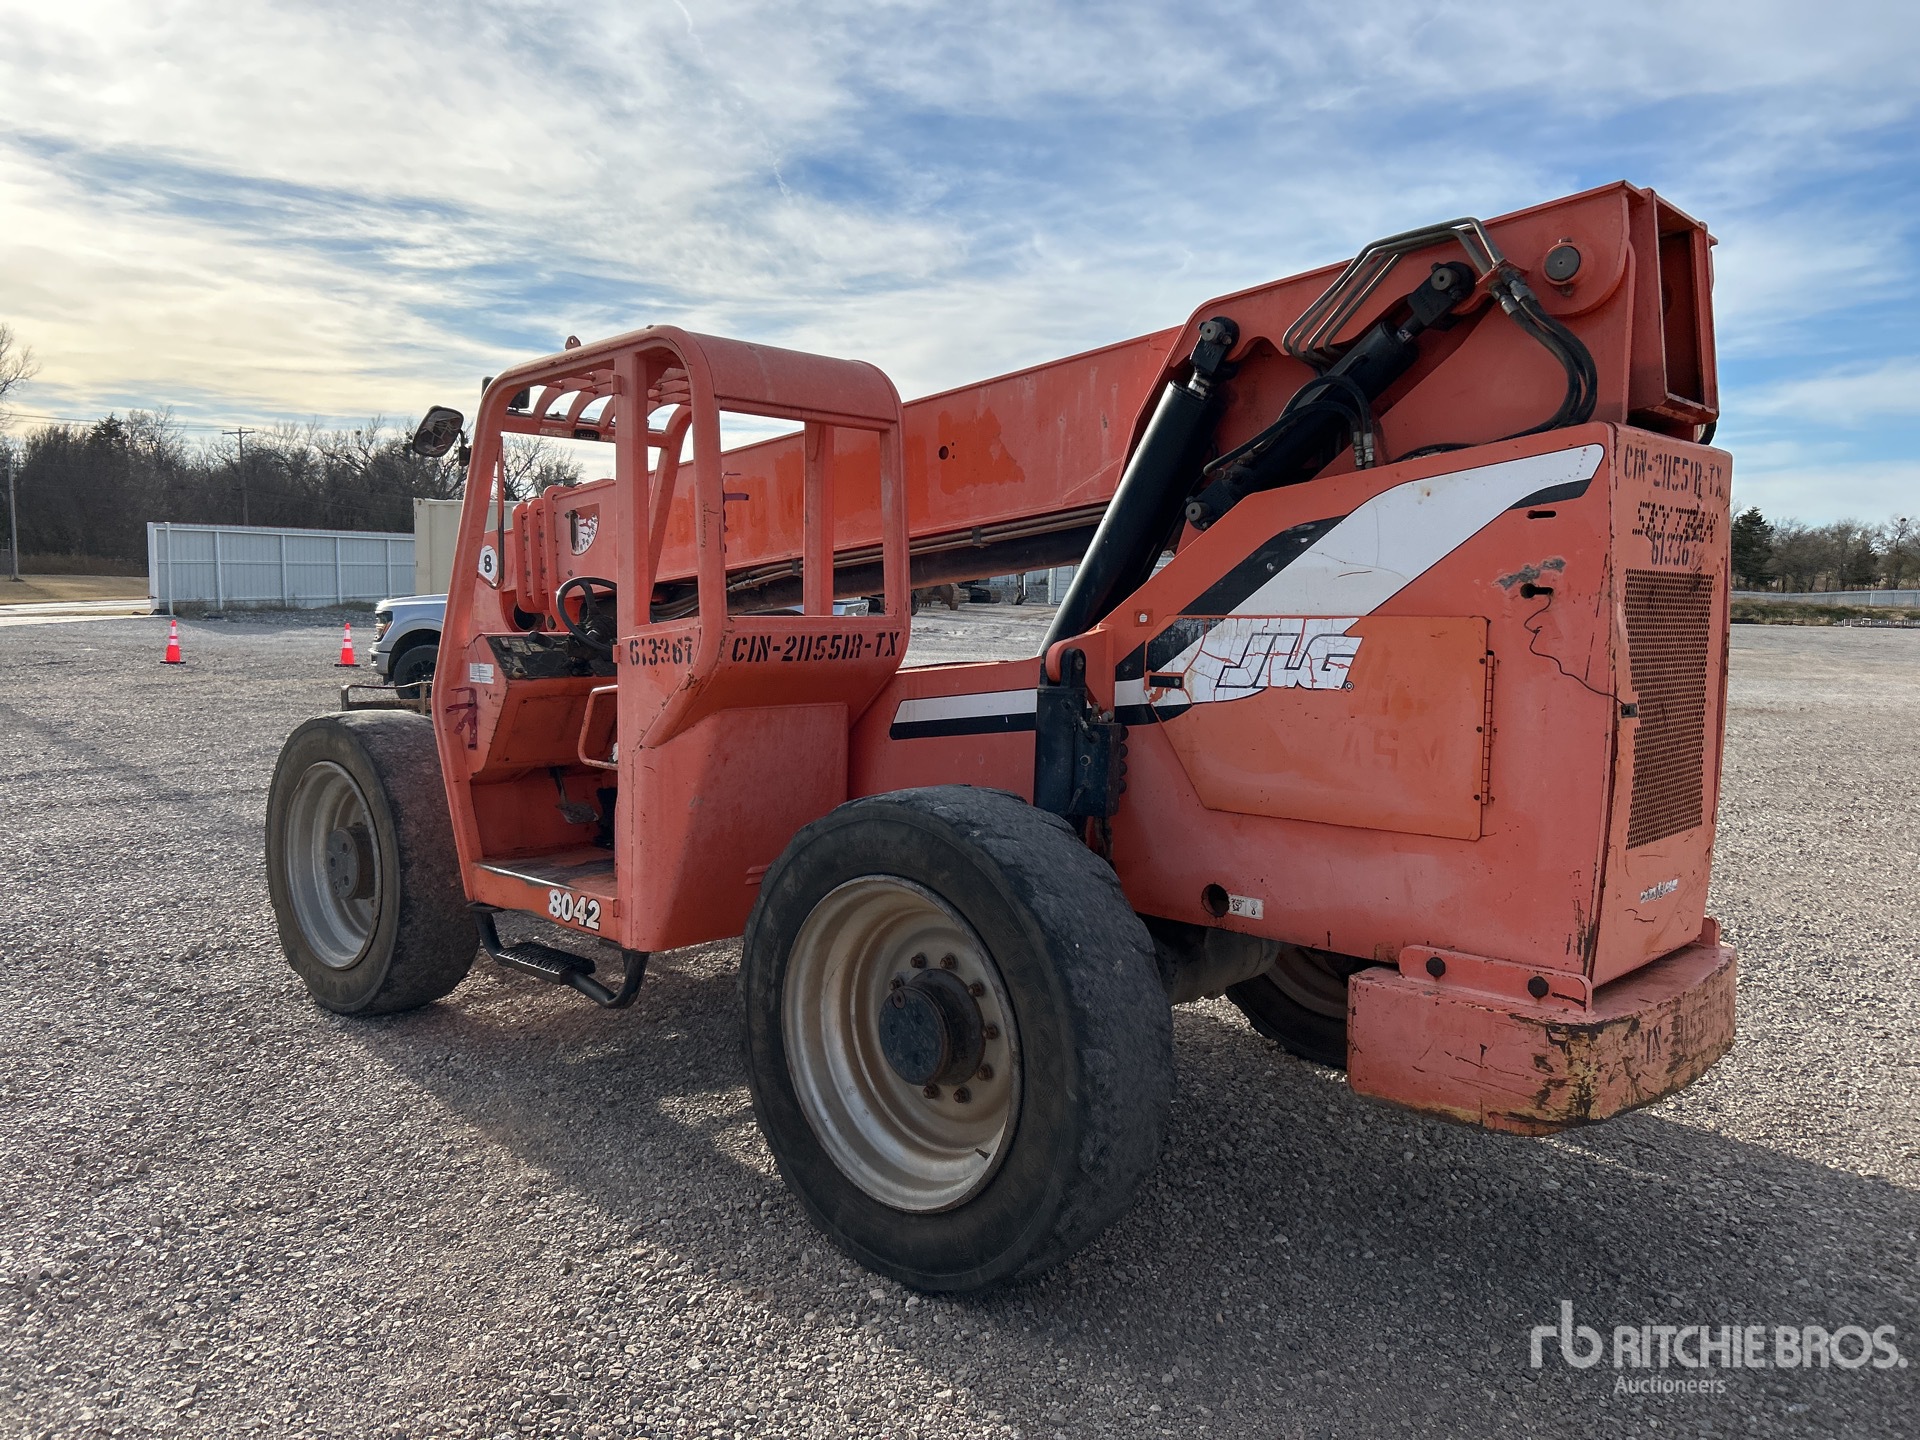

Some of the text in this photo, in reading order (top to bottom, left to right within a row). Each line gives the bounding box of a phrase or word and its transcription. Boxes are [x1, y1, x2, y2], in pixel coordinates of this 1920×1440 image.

[483, 554, 493, 574] 8
[629, 635, 694, 667] 613367
[731, 631, 901, 663] CIN-211551R-TX
[1215, 633, 1364, 690] JLG
[548, 888, 601, 931] 8042
